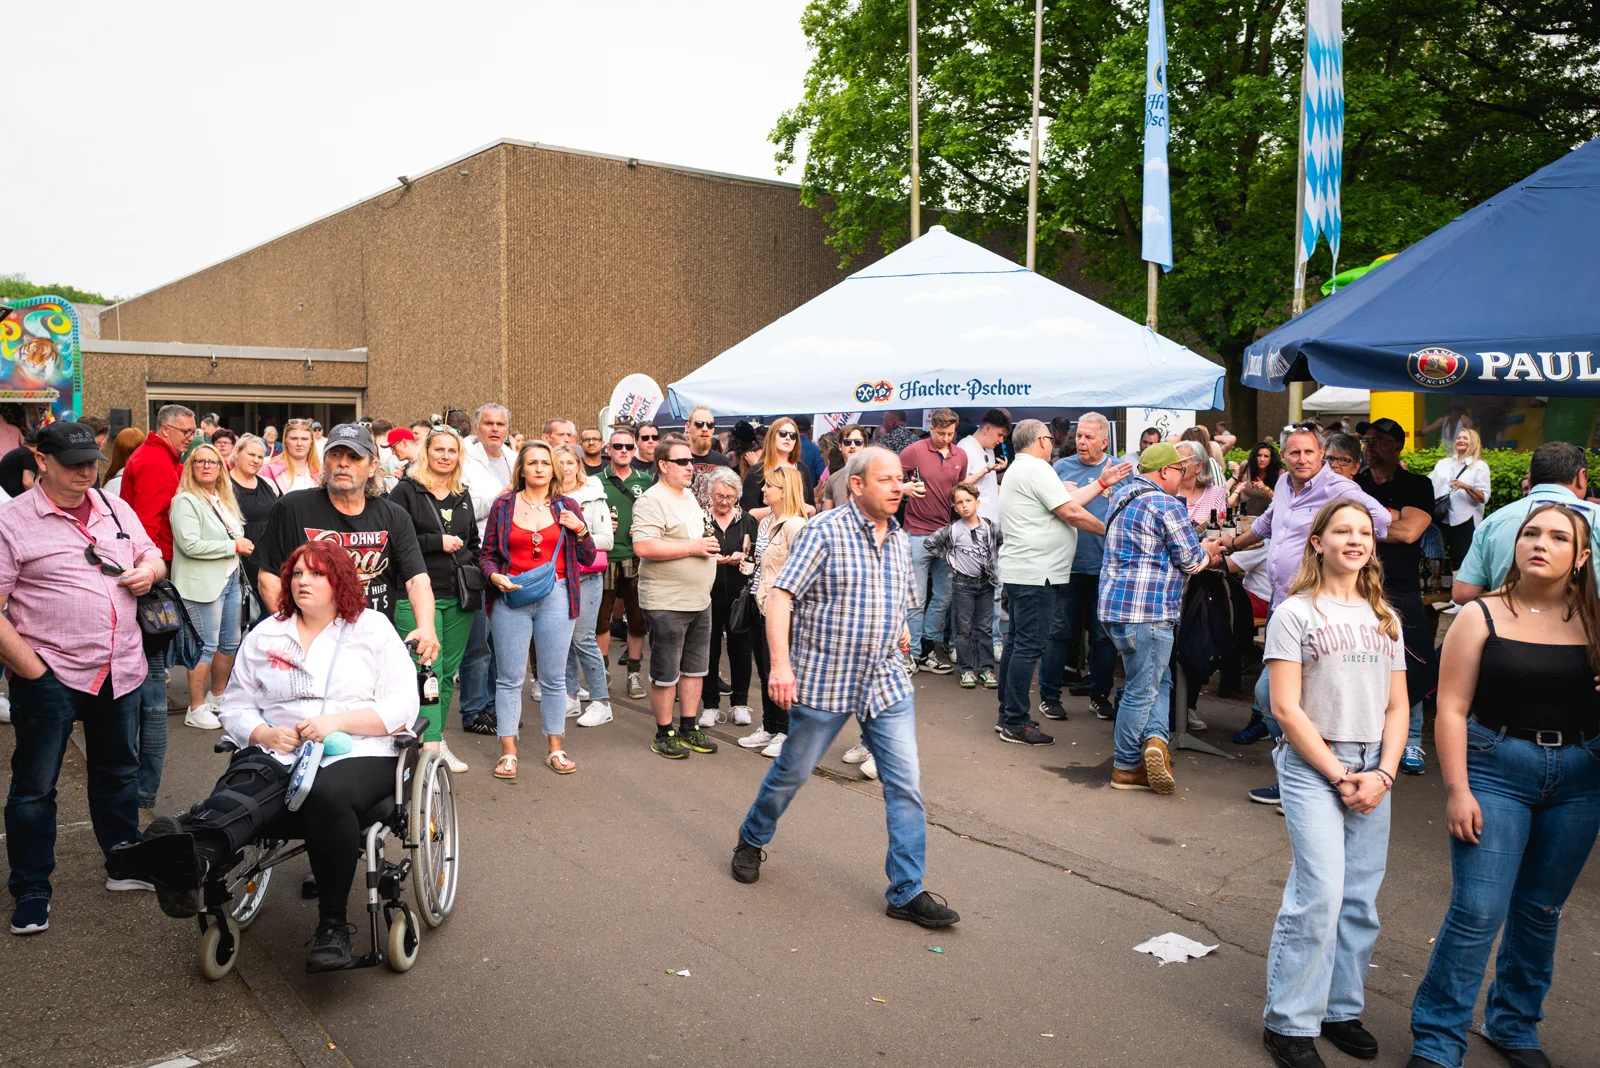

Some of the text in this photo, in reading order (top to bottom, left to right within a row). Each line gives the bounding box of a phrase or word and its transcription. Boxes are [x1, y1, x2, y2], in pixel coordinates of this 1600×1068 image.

[1413, 372, 1457, 385] MÜNCHEN
[899, 378, 1032, 401] Hacker-Pschorr
[349, 533, 382, 545] OHNE
[371, 583, 388, 595] HIER
[1307, 623, 1357, 663] SQUAD
[1342, 654, 1366, 663] SINCE
